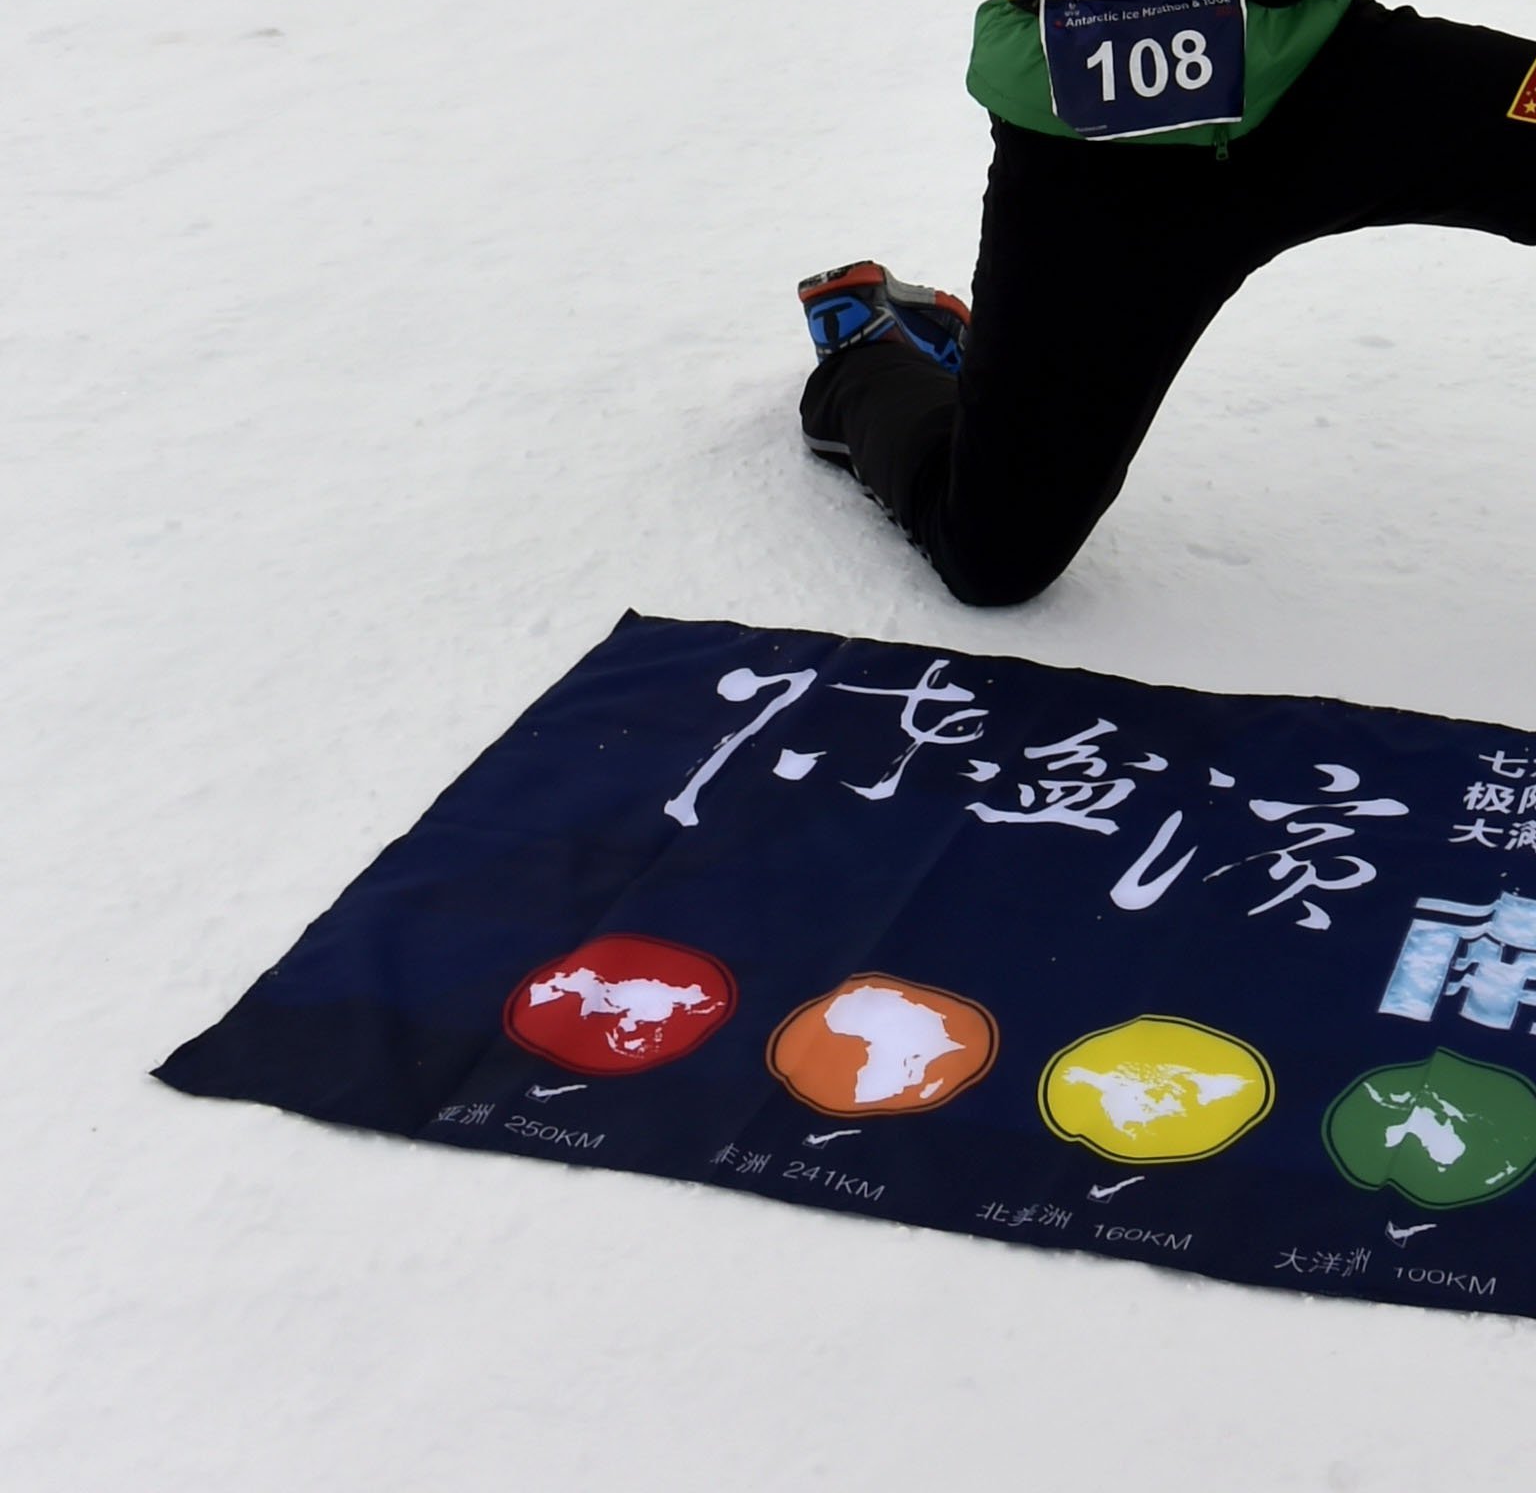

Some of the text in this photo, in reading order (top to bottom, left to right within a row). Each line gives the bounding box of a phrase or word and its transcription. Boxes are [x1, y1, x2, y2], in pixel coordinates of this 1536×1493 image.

[1064, 11, 1119, 29] Antarctic
[1122, 6, 1140, 21] Ice
[1086, 29, 1214, 102] 108
[504, 1115, 606, 1150] 250KM
[782, 1161, 887, 1203] 241KM
[1092, 1223, 1194, 1252] 160KM
[1273, 1247, 1497, 1296] 大洋洲 100KM
